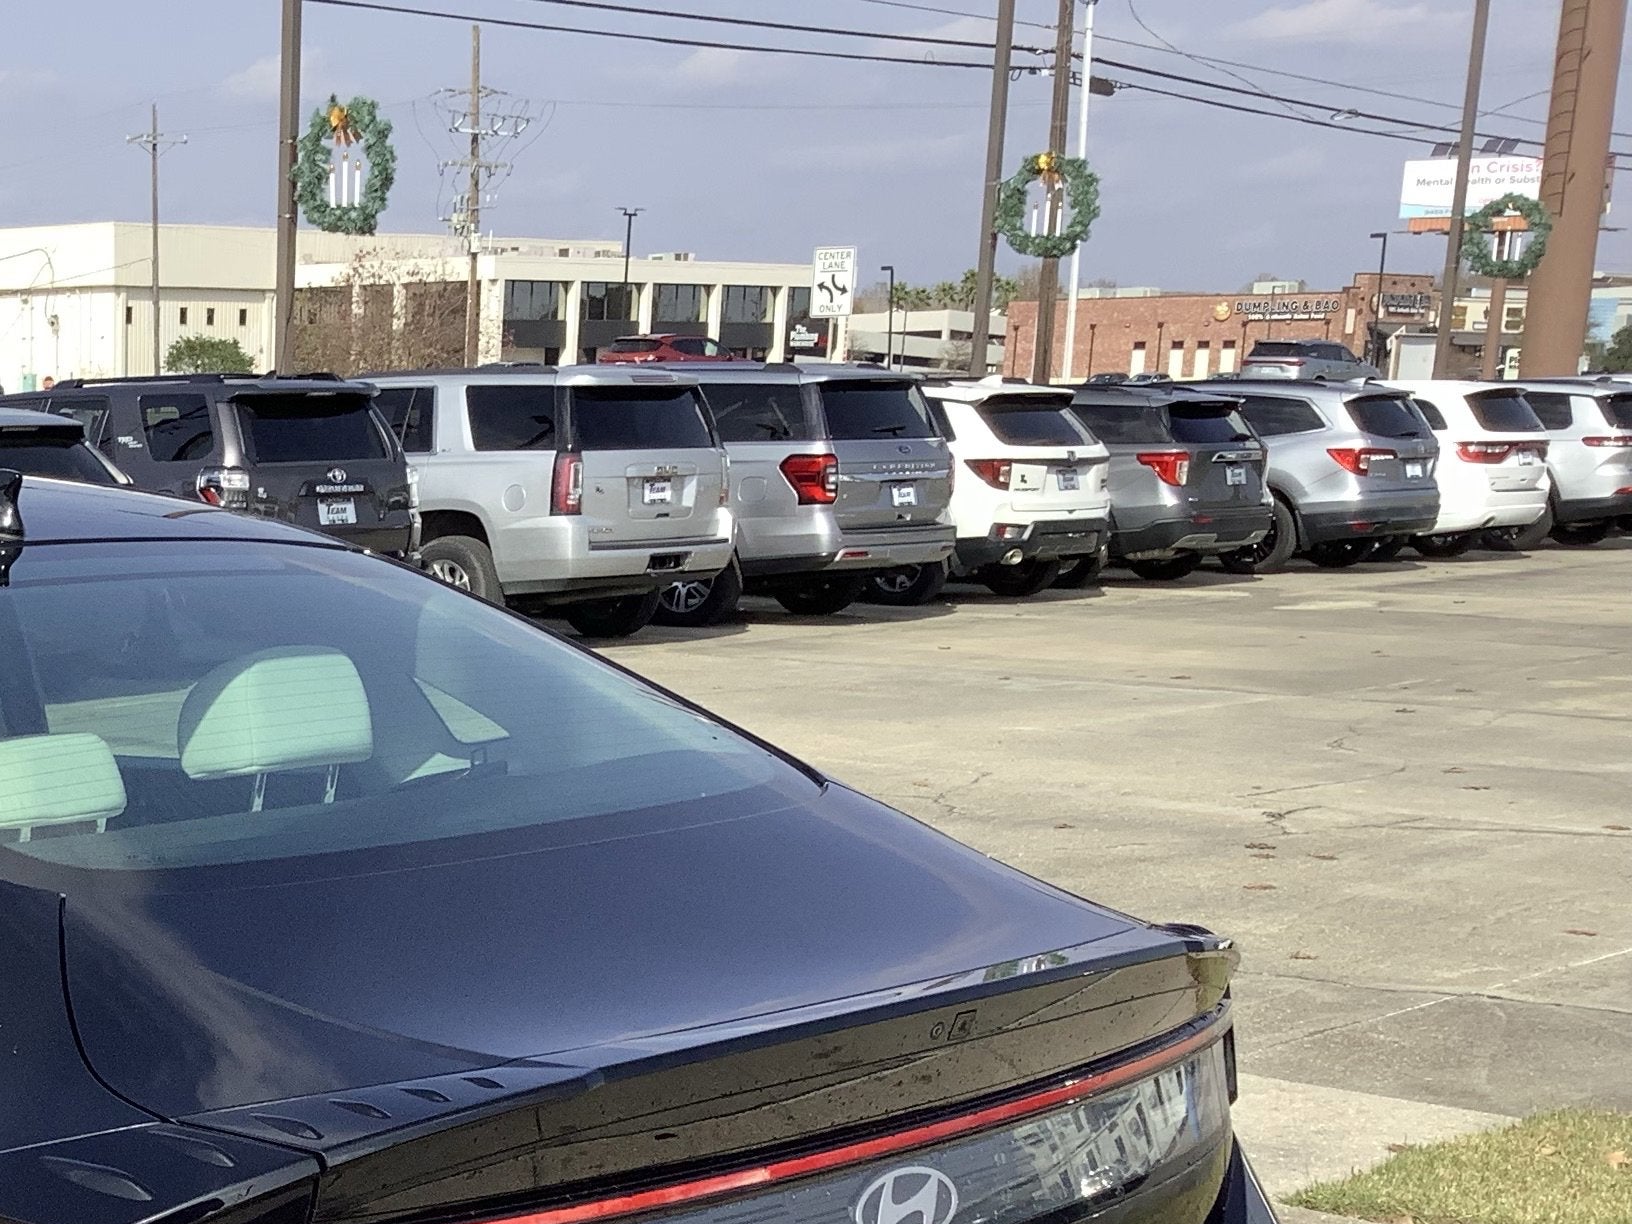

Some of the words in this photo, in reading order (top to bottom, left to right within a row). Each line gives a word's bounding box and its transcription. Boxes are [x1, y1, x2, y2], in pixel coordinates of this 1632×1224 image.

[1416, 177, 1453, 187] Mental
[1469, 175, 1492, 185] alth
[1494, 177, 1506, 185] or
[817, 250, 852, 261] CENTER
[822, 260, 846, 270] LANE
[819, 303, 843, 313] ONLY
[1235, 301, 1298, 314] DUMPING
[1302, 300, 1312, 312] &
[1314, 300, 1340, 313] BAO
